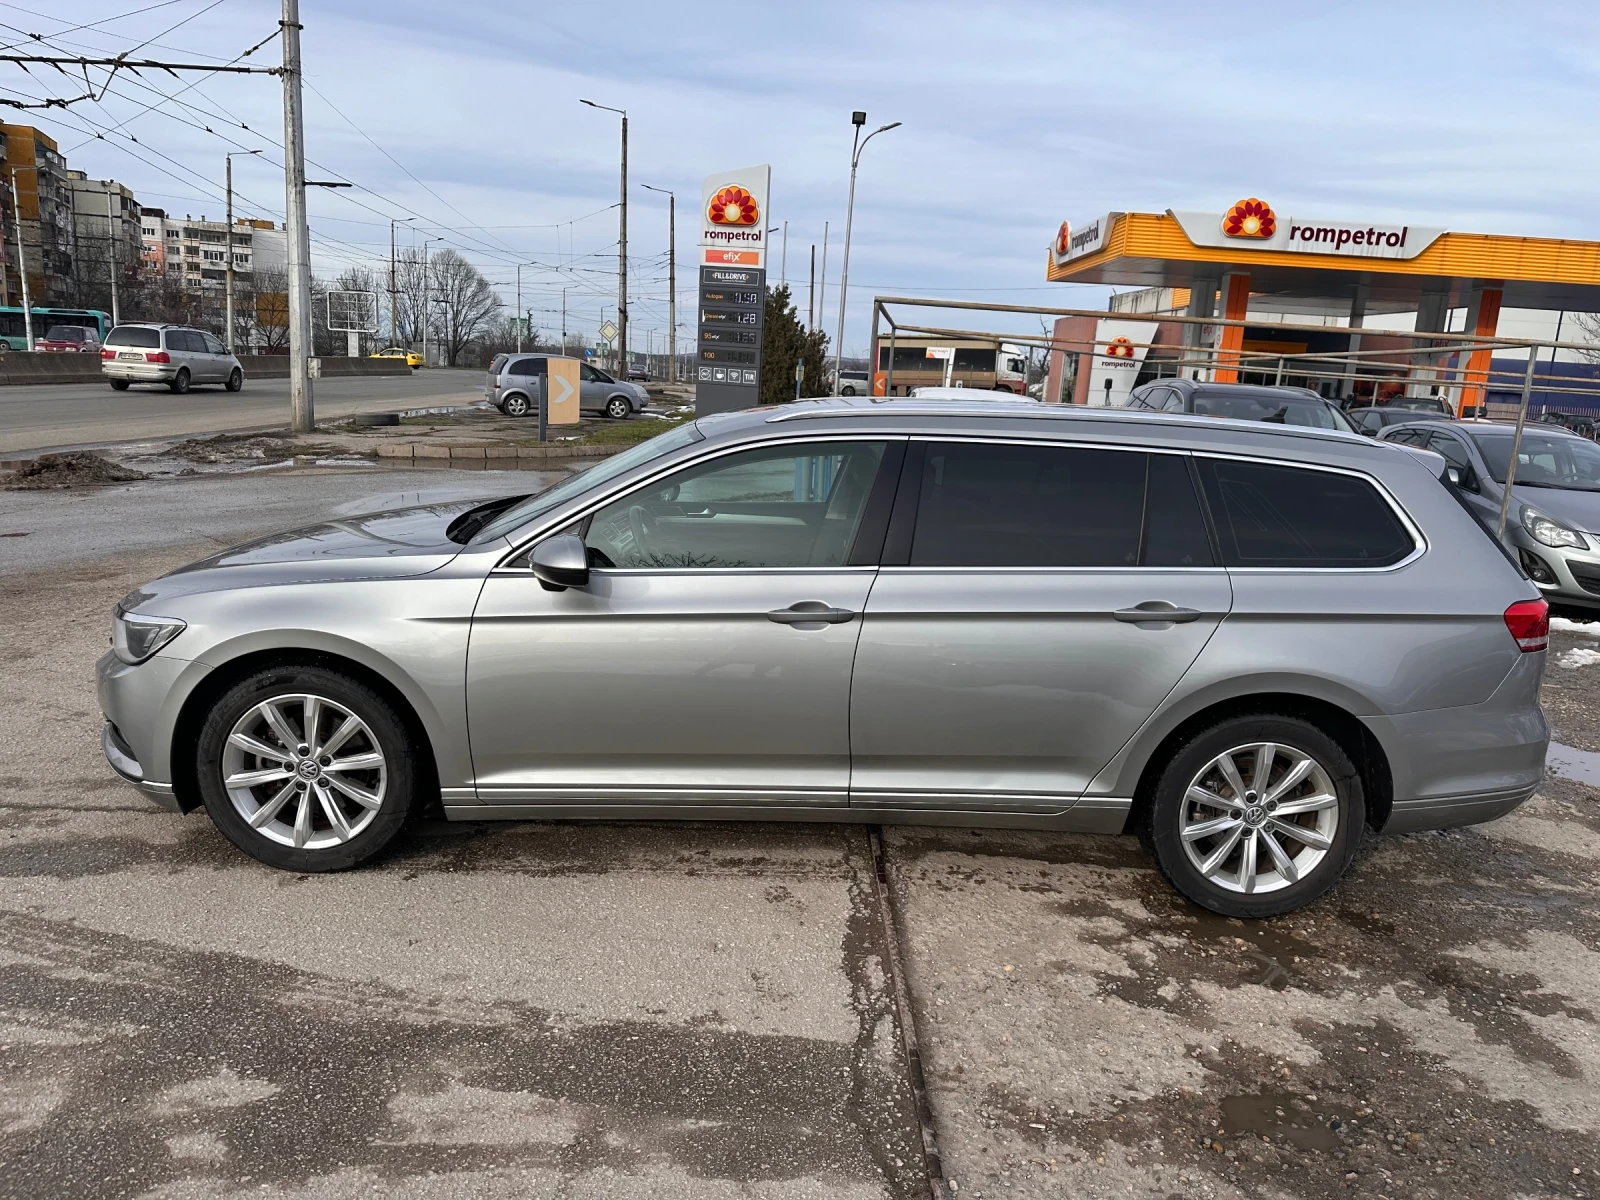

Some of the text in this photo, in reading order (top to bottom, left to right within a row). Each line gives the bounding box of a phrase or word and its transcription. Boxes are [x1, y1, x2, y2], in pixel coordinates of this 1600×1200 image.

[704, 229, 761, 243] rompetrol
[1072, 219, 1099, 251] rompetrol
[1290, 226, 1408, 250] rompetrol
[723, 252, 742, 262] efix
